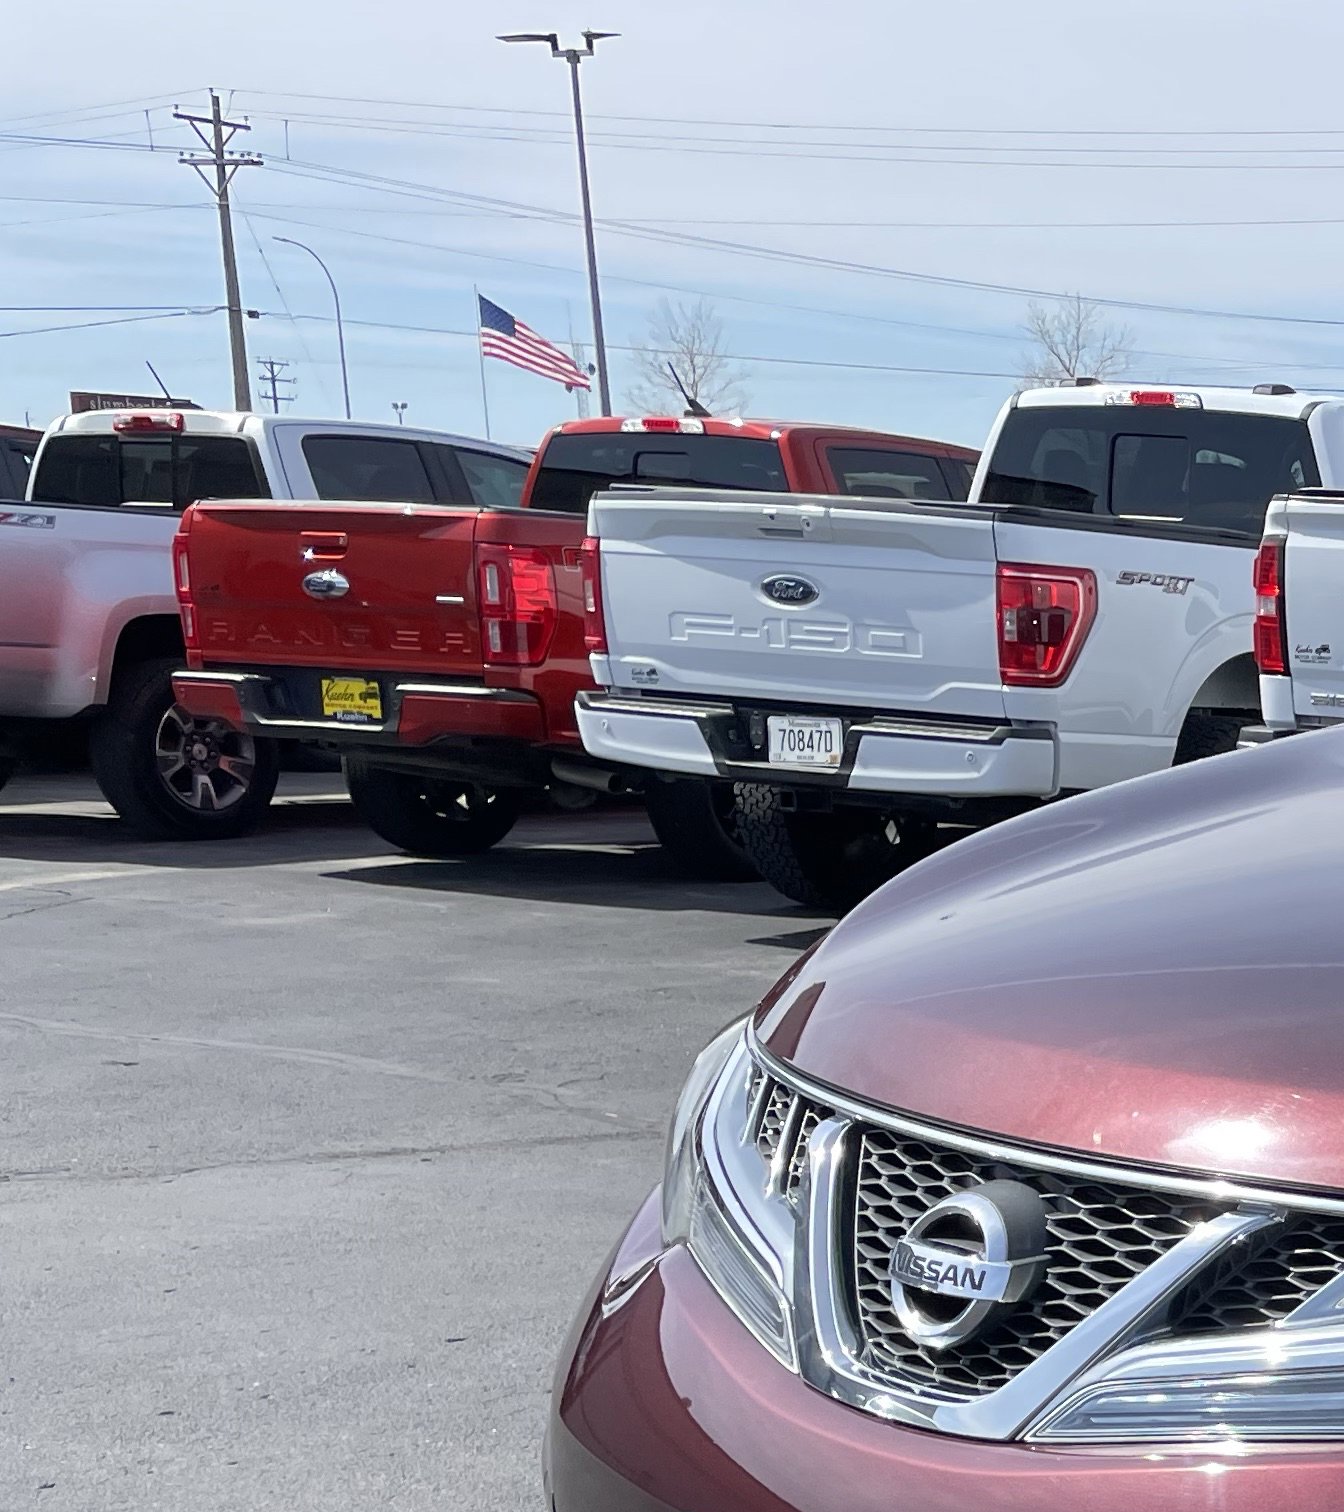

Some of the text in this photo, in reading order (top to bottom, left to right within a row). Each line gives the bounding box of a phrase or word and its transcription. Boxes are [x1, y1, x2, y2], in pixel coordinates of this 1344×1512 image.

[772, 580, 804, 599] Ford
[208, 621, 473, 653] RANGER
[667, 610, 924, 658] F-150
[322, 682, 355, 702] Kuehn
[892, 1252, 987, 1291] NISSAN
